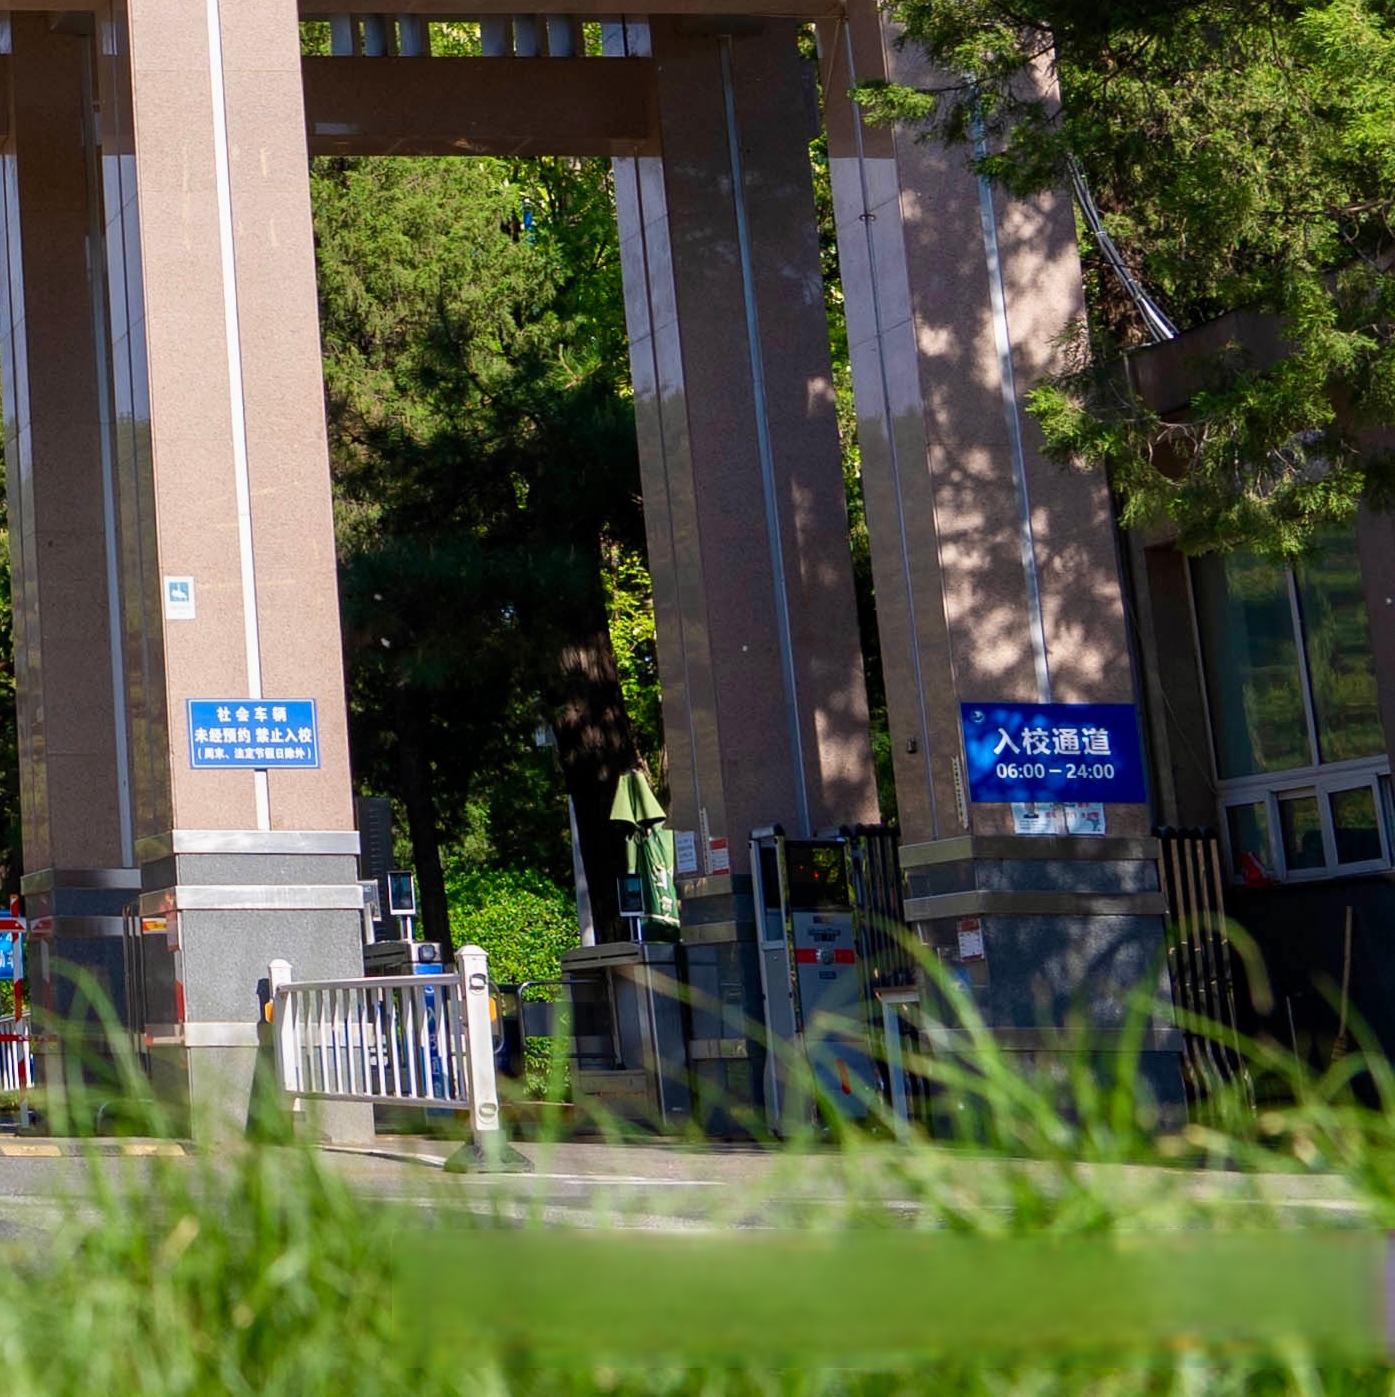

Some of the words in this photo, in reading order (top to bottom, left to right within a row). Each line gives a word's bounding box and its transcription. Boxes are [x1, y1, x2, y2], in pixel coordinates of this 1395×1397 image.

[993, 727, 1111, 755] 入校通道
[996, 763, 1045, 779] 06:00
[1065, 763, 1115, 779] 24:00
